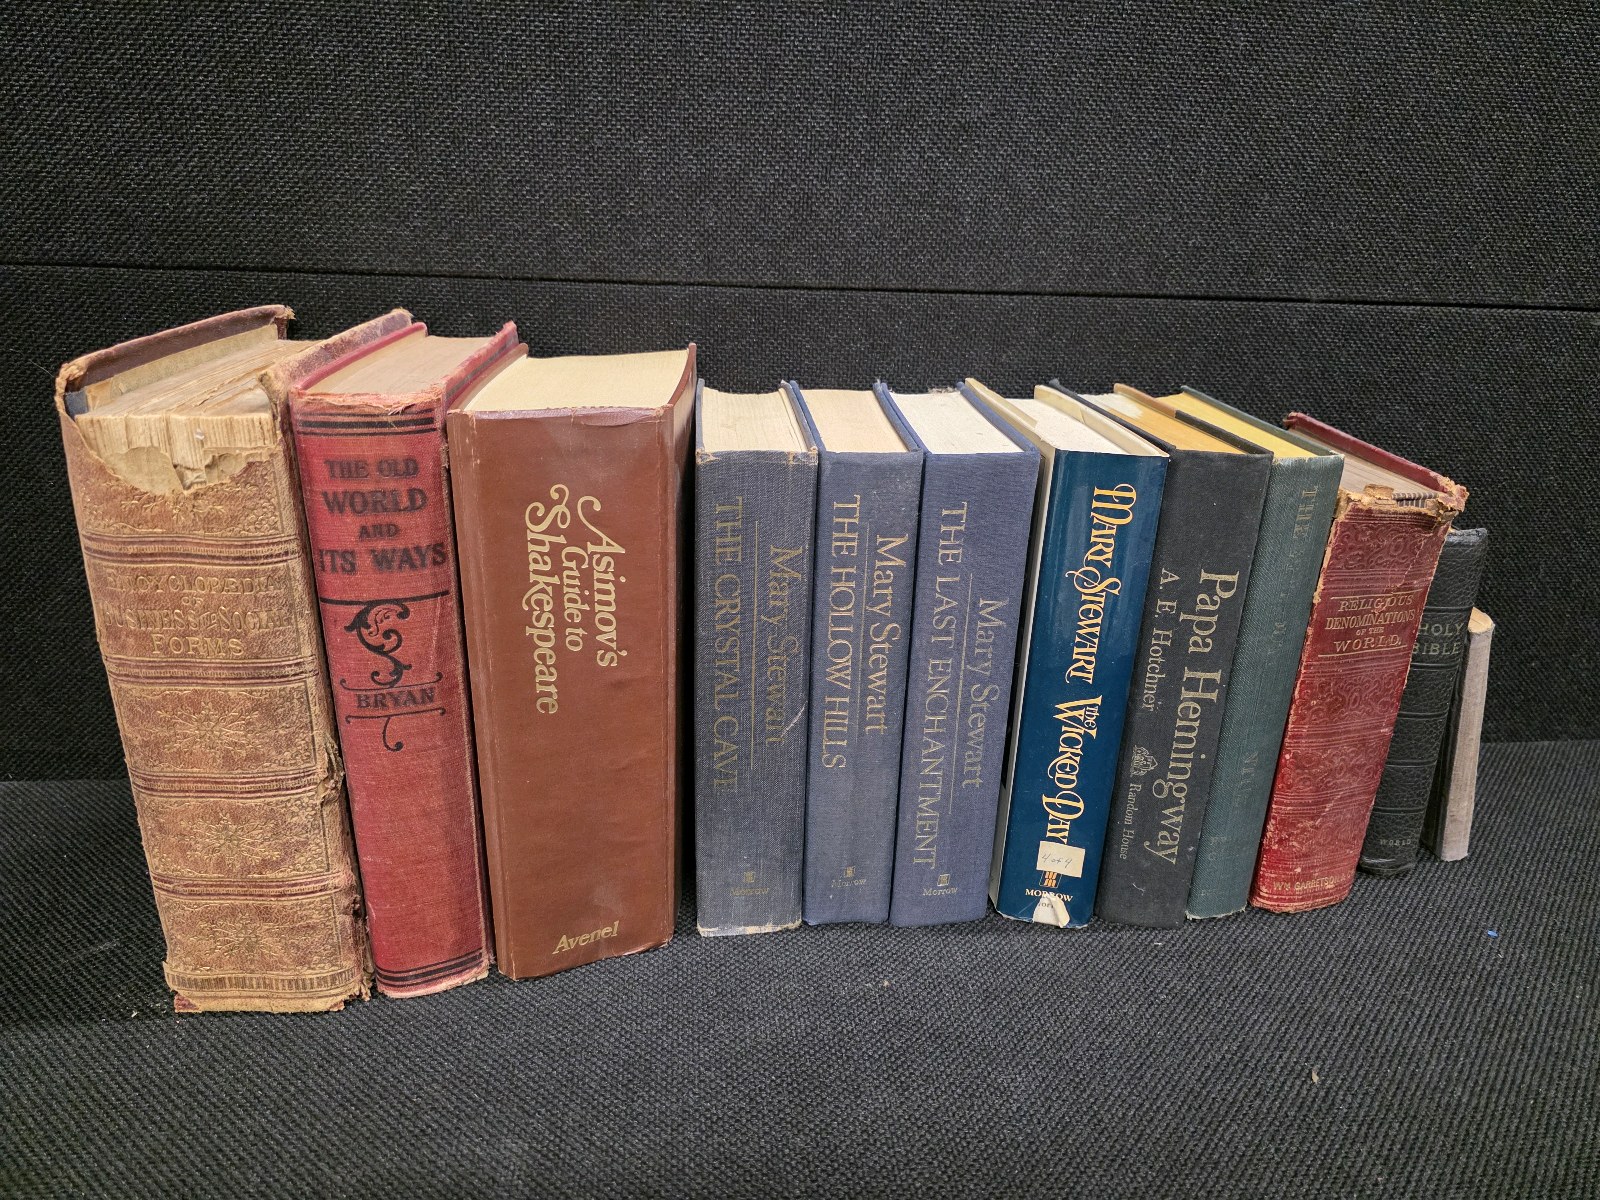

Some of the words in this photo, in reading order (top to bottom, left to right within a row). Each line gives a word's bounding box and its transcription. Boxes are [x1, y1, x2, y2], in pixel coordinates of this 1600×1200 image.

[321, 487, 428, 516] WORLD
[324, 459, 370, 479] THE
[377, 457, 419, 478] OLD
[318, 548, 358, 576] ITS
[370, 542, 447, 572] WAYS
[358, 523, 400, 540] AND
[715, 496, 743, 566] THE
[831, 494, 861, 558] THE
[938, 501, 968, 566] THE
[1083, 483, 1137, 568] MARY
[521, 483, 571, 714] Shakespeare
[561, 546, 591, 623] Guide
[577, 495, 628, 667] Asimov's
[760, 544, 804, 625] Mary
[865, 533, 909, 618] Mary
[1154, 598, 1178, 618] E.
[1159, 567, 1181, 590] A.
[1338, 595, 1414, 612] RELIGIOUS
[151, 633, 245, 657] FORMS
[565, 627, 588, 652] to
[714, 573, 741, 711] CRYSTAL
[826, 565, 857, 690] HOLLOW
[931, 574, 961, 649] LAST
[966, 597, 1010, 678] Mary
[1179, 569, 1240, 654] Papa
[1325, 609, 1416, 630] DENOMINATIONS
[1418, 623, 1464, 636] HOLY
[864, 622, 902, 735] Stewart
[1141, 627, 1173, 711] Hotchner
[1412, 642, 1461, 655] BIBLE
[355, 687, 436, 709] BRYAN
[765, 635, 800, 747] Stewart
[712, 715, 740, 793] CAVE
[822, 695, 850, 768] HILLS
[912, 658, 953, 869] ENCHANTMENT
[961, 683, 1000, 789] Stewart
[1143, 666, 1222, 865] Hemingway
[1042, 790, 1085, 845] DAY
[1124, 783, 1142, 825] Random
[1119, 828, 1135, 860] House
[922, 887, 958, 896] Morrow
[551, 920, 620, 955] Avenel
